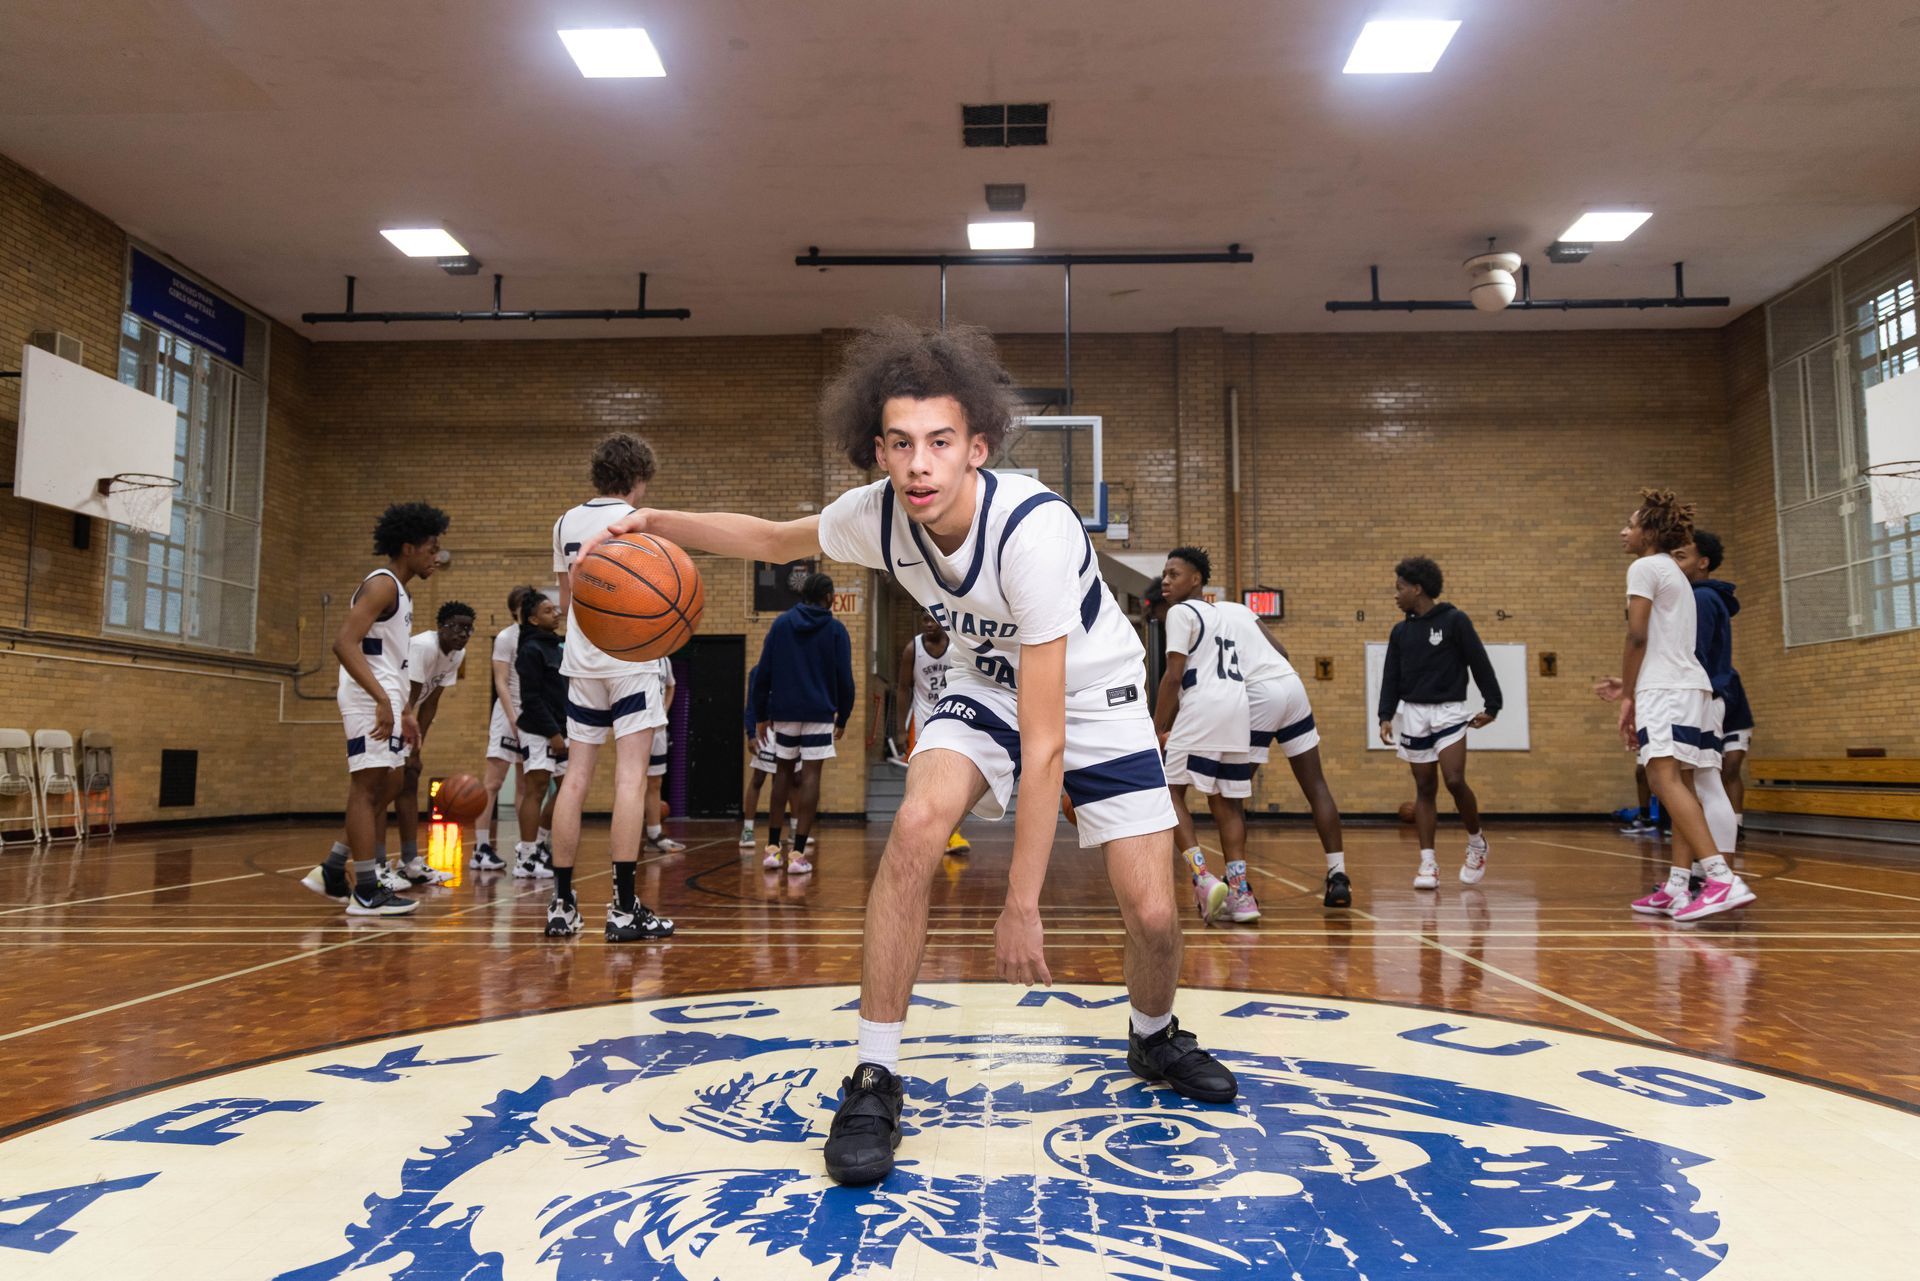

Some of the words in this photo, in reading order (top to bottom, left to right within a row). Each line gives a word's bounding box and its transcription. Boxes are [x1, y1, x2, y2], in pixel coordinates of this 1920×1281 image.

[833, 593, 856, 613] EXIT
[1249, 591, 1276, 614] EXIT
[1356, 609, 1365, 622] 8
[1214, 636, 1244, 682] 13
[930, 676, 947, 690] 24
[933, 700, 977, 720] EARS
